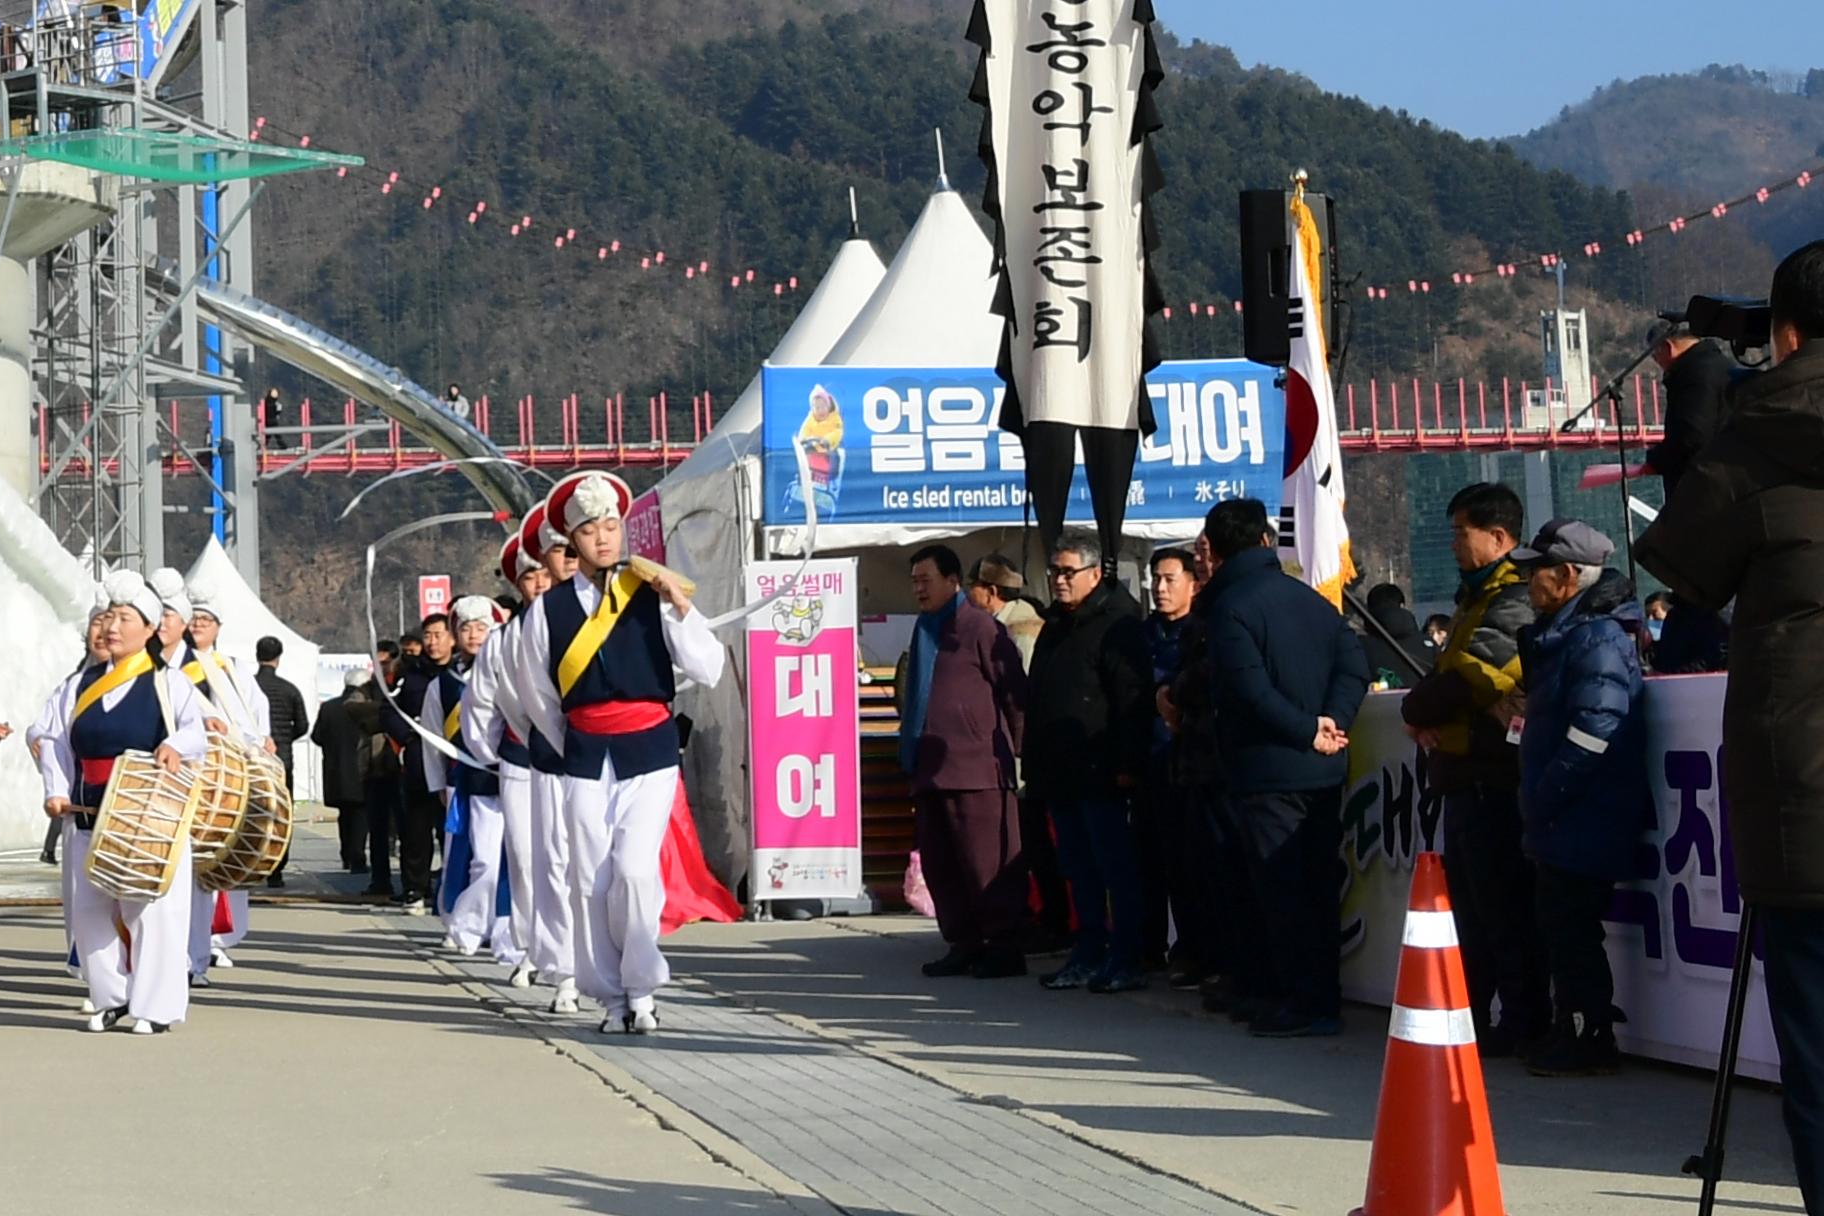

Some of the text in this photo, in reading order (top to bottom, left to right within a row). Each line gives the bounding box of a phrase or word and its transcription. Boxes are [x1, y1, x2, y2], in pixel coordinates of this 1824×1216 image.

[1140, 380, 1265, 467] 대여
[883, 485, 908, 509] Ice
[912, 484, 950, 508] sled
[954, 483, 1007, 507] rental
[775, 653, 836, 819] 대여
